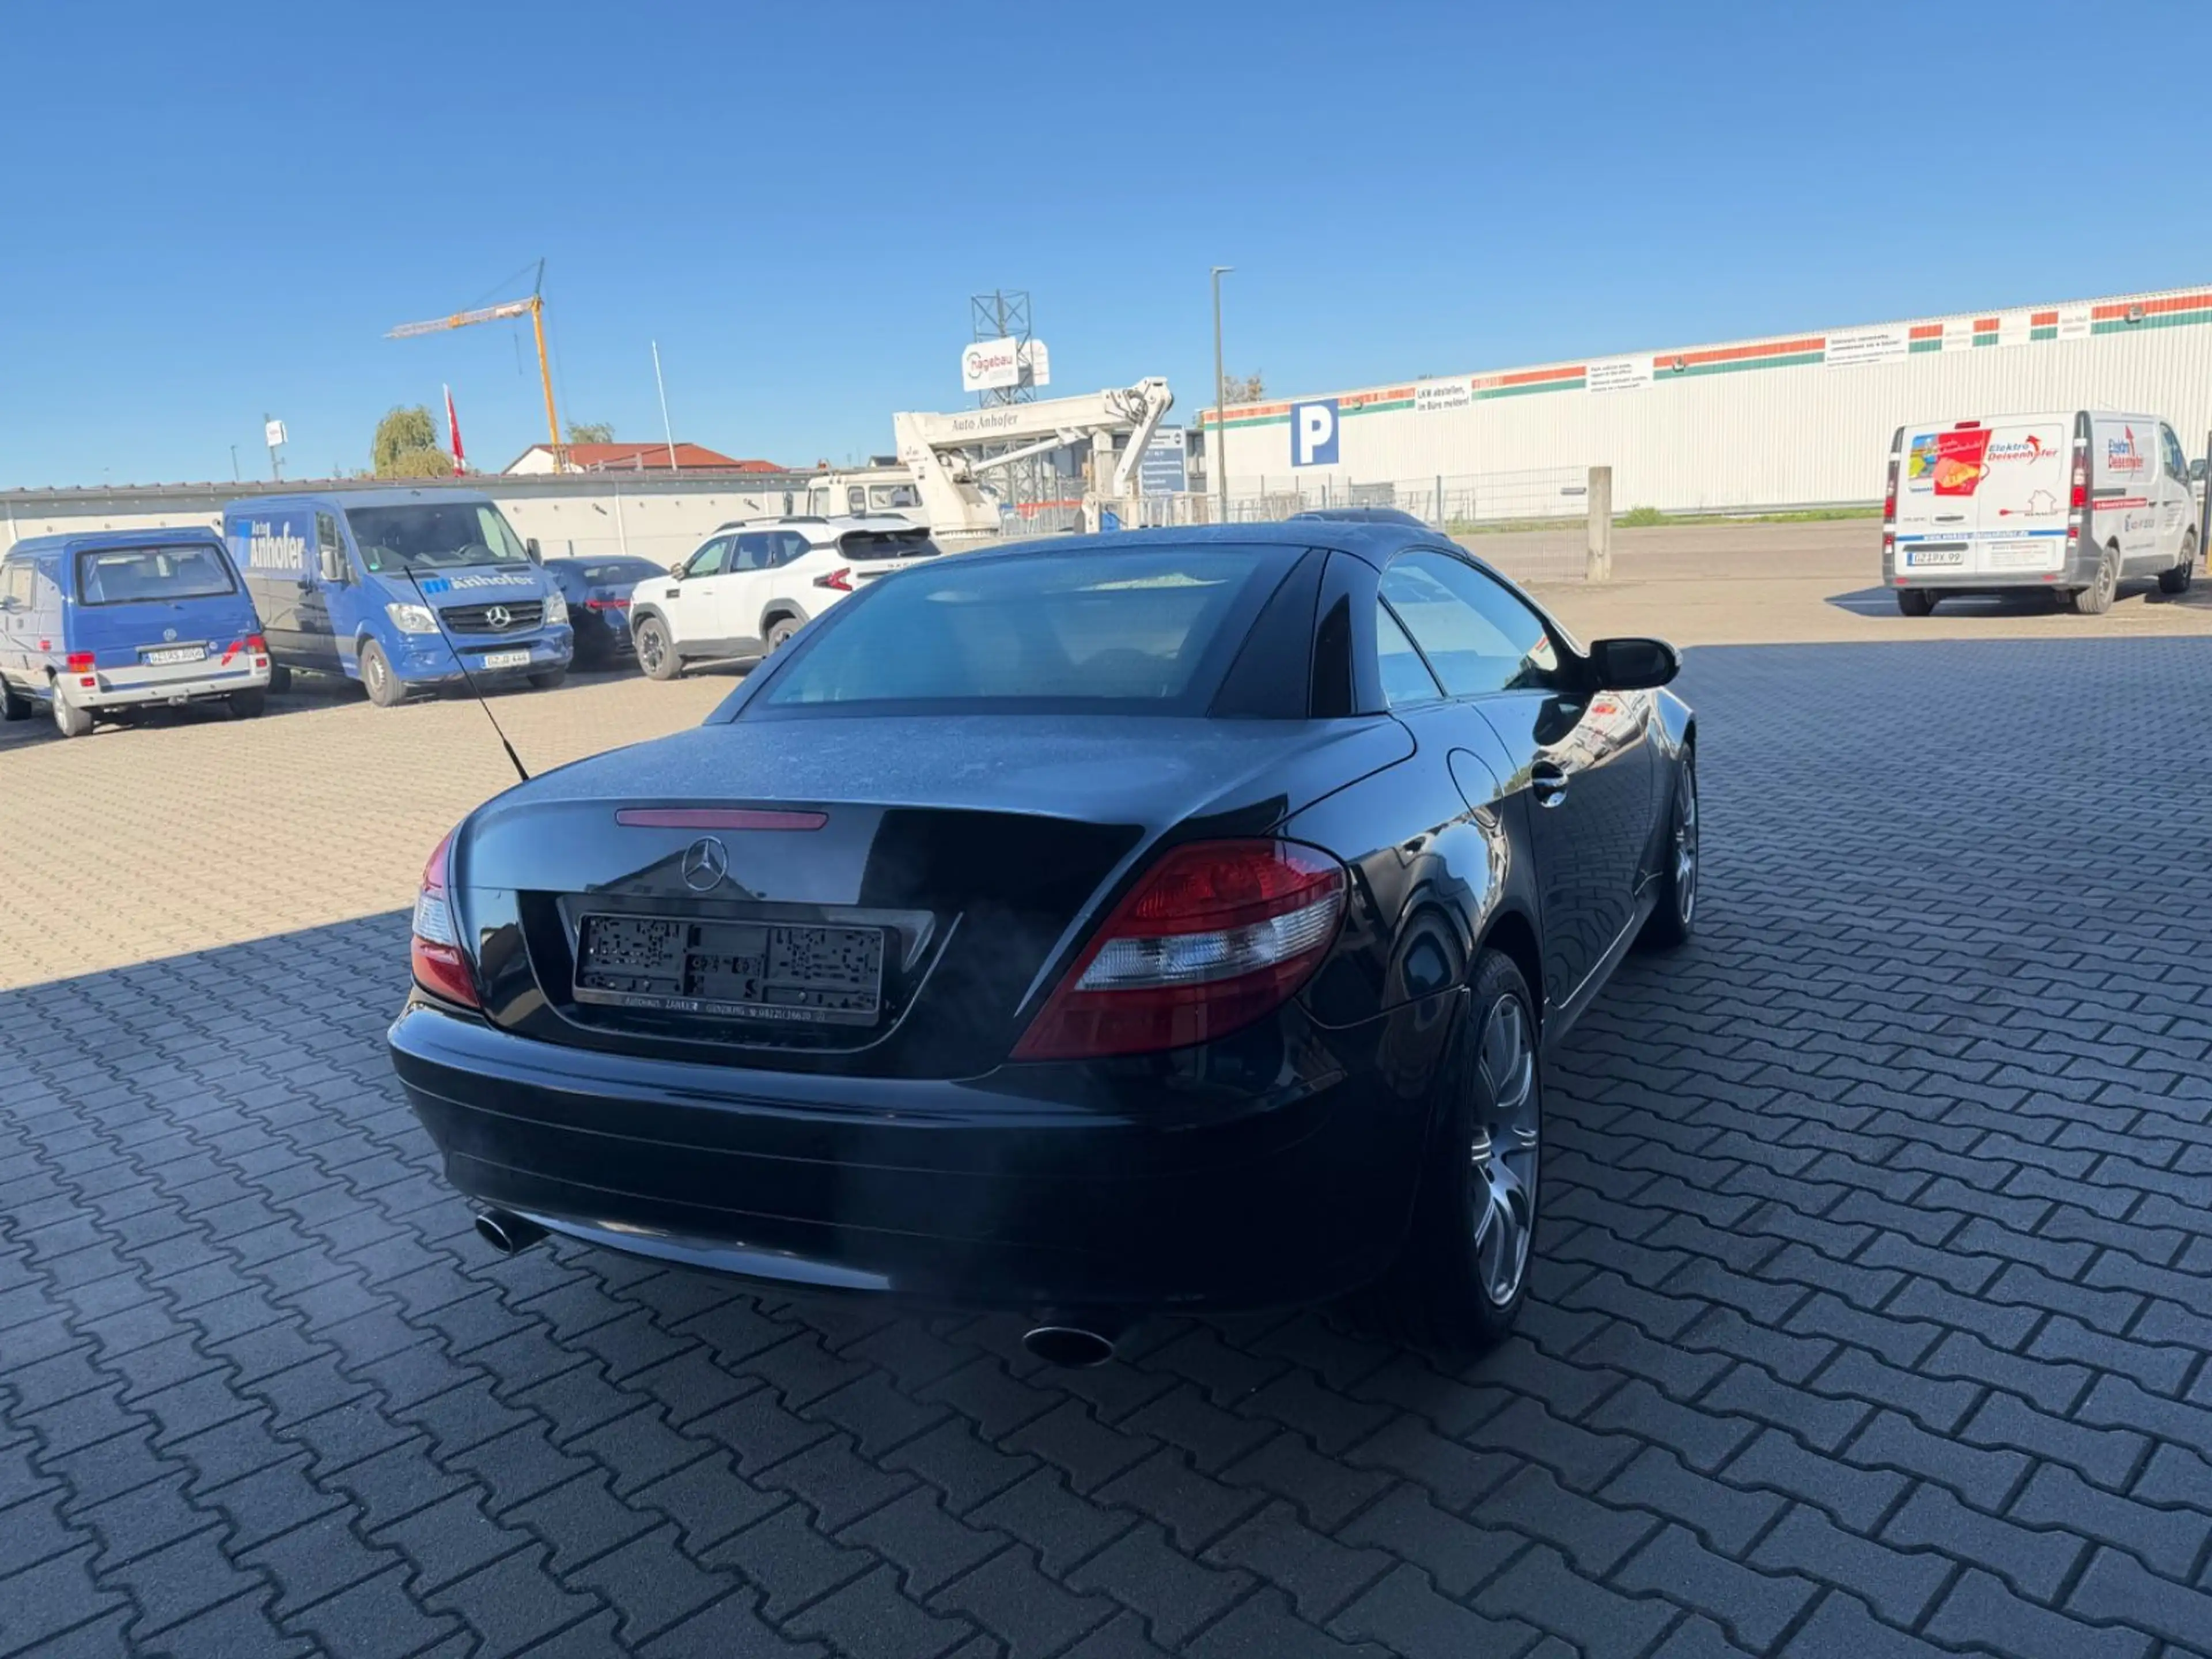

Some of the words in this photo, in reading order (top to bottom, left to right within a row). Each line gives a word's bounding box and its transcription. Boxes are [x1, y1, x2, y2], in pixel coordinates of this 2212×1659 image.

[971, 355, 1013, 372] hagebau
[952, 419, 976, 431] Auto
[977, 412, 1018, 430] Anhofer
[1300, 405, 1333, 464] P
[1988, 442, 2029, 452] Elektro
[251, 521, 305, 570] Anhofer
